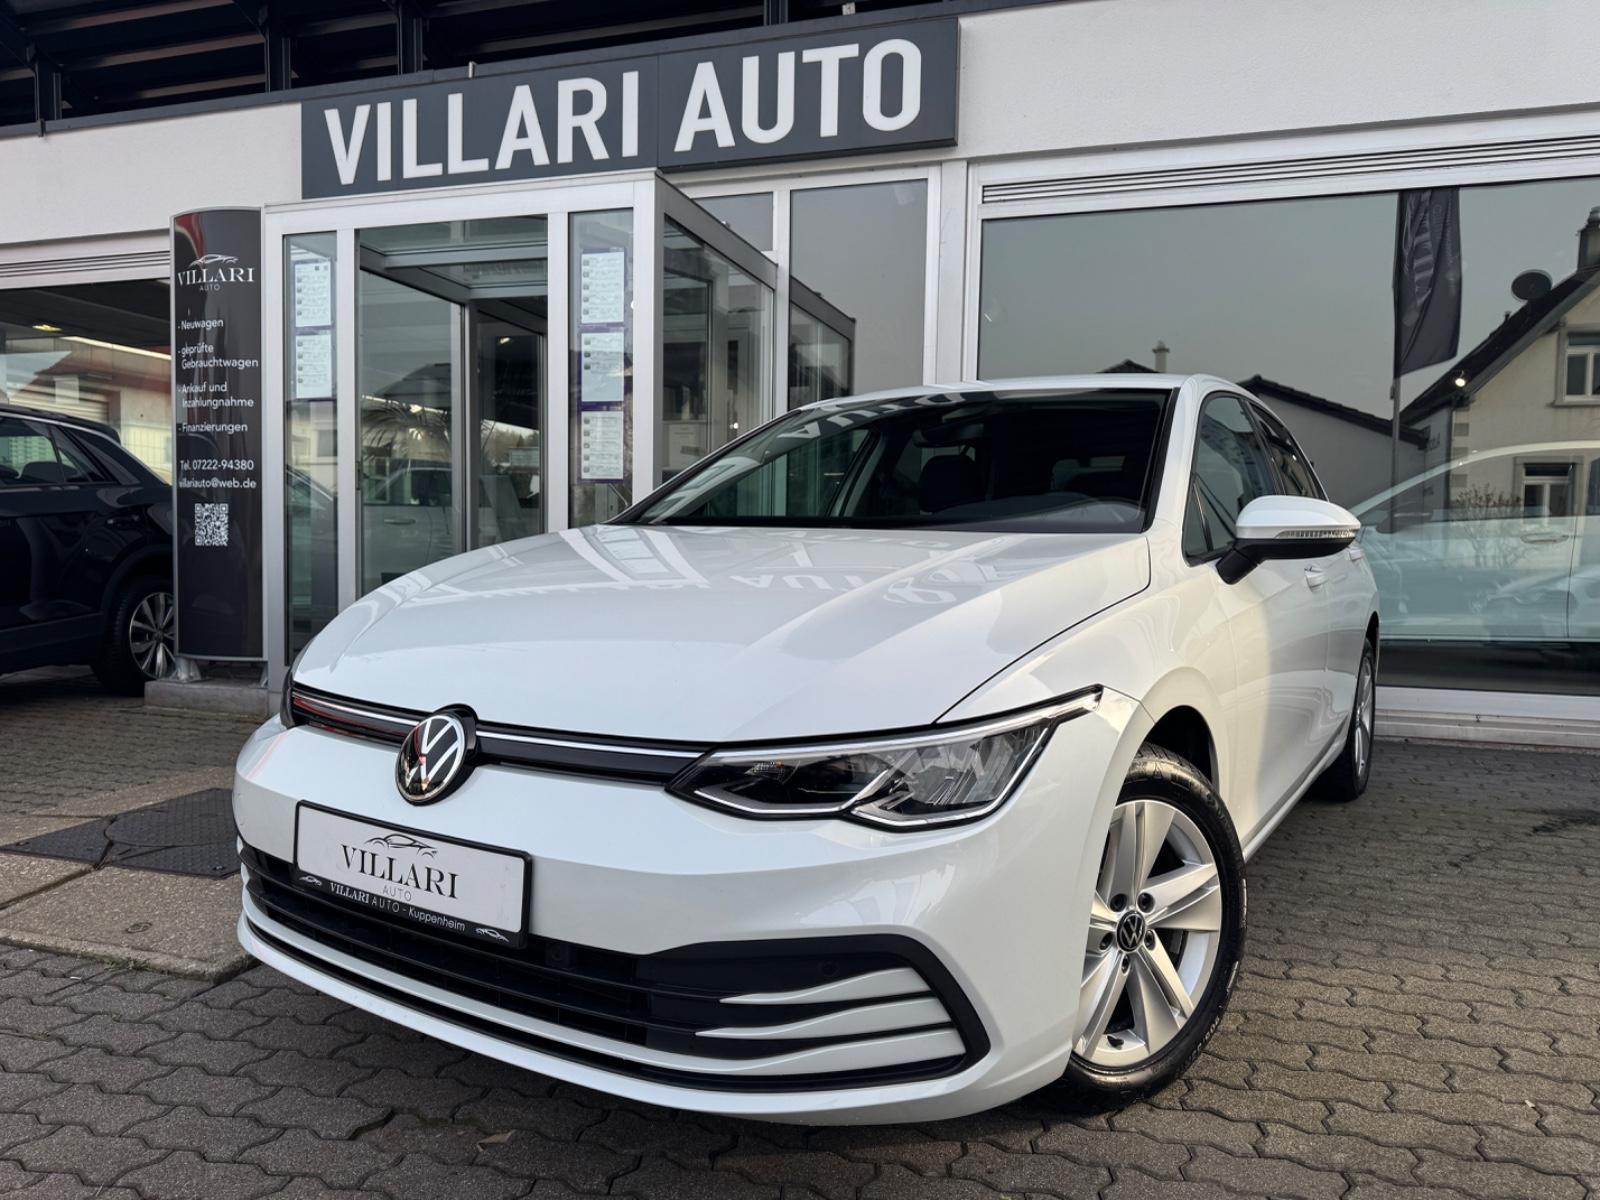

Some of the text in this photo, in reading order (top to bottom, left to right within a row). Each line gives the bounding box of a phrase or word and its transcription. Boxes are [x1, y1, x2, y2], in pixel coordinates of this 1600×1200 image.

[324, 38, 922, 185] VILLARI AUTO
[177, 267, 254, 286] VILLARI
[199, 283, 220, 291] AUTO
[181, 319, 224, 331] Neuwagen
[182, 356, 259, 370] Gebrauchtwagen
[182, 381, 227, 393] Ankauf und
[182, 422, 248, 434] Finanzierungen
[192, 459, 254, 470] 07222-94380
[341, 844, 459, 899] VILLARI
[382, 885, 412, 902] AUTO
[330, 882, 369, 904] VILLARI
[371, 899, 400, 913] AUTO
[408, 906, 466, 932] Kuppenheim
